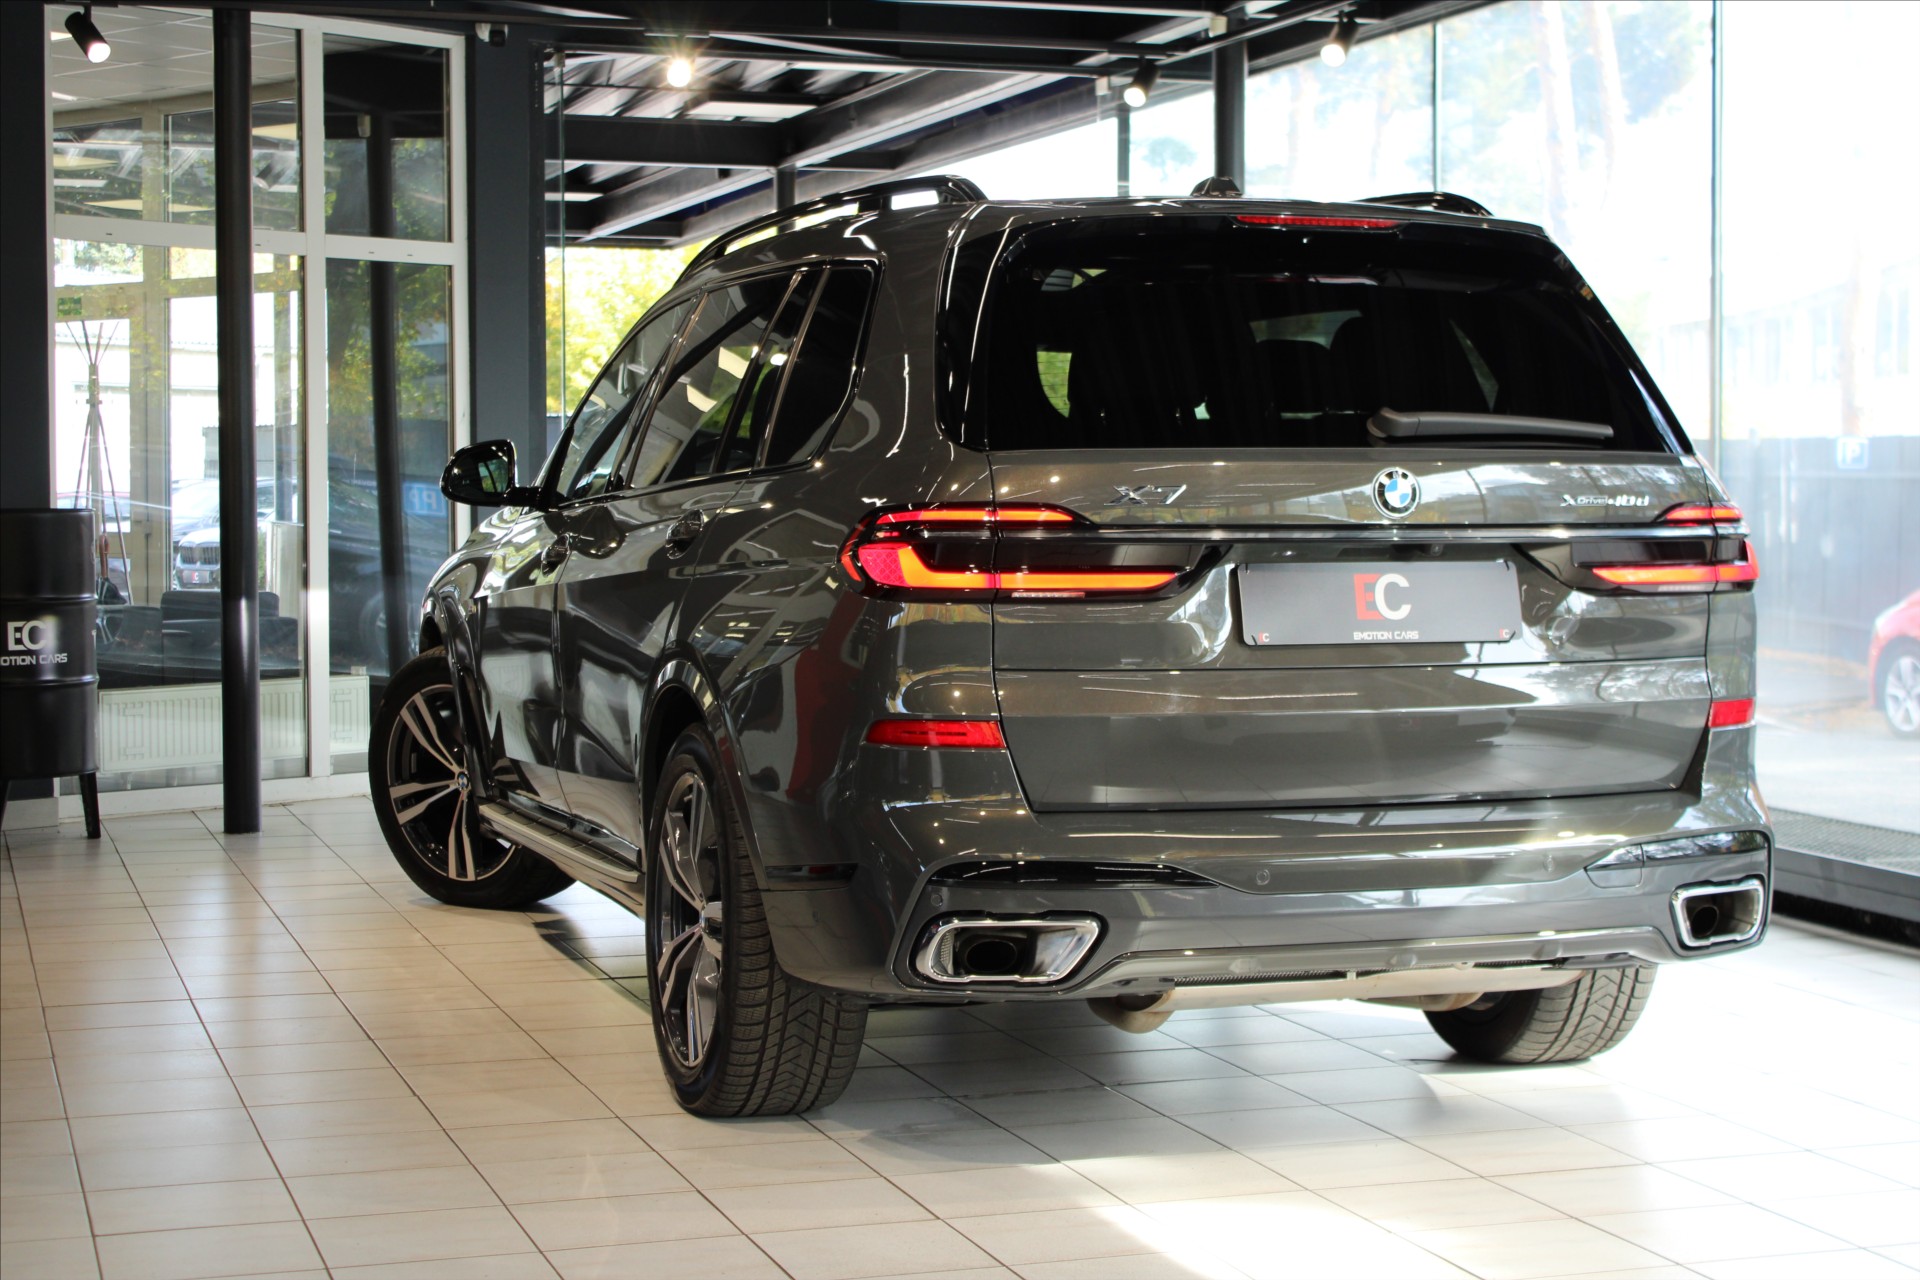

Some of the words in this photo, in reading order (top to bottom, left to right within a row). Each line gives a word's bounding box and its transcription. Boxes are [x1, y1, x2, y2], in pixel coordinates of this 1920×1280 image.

[1104, 484, 1187, 506] X7
[1354, 573, 1412, 621] EC
[7, 620, 47, 651] EC
[1353, 631, 1392, 641] EMOTION
[1394, 631, 1419, 640] CARS
[39, 653, 68, 665] CARS
